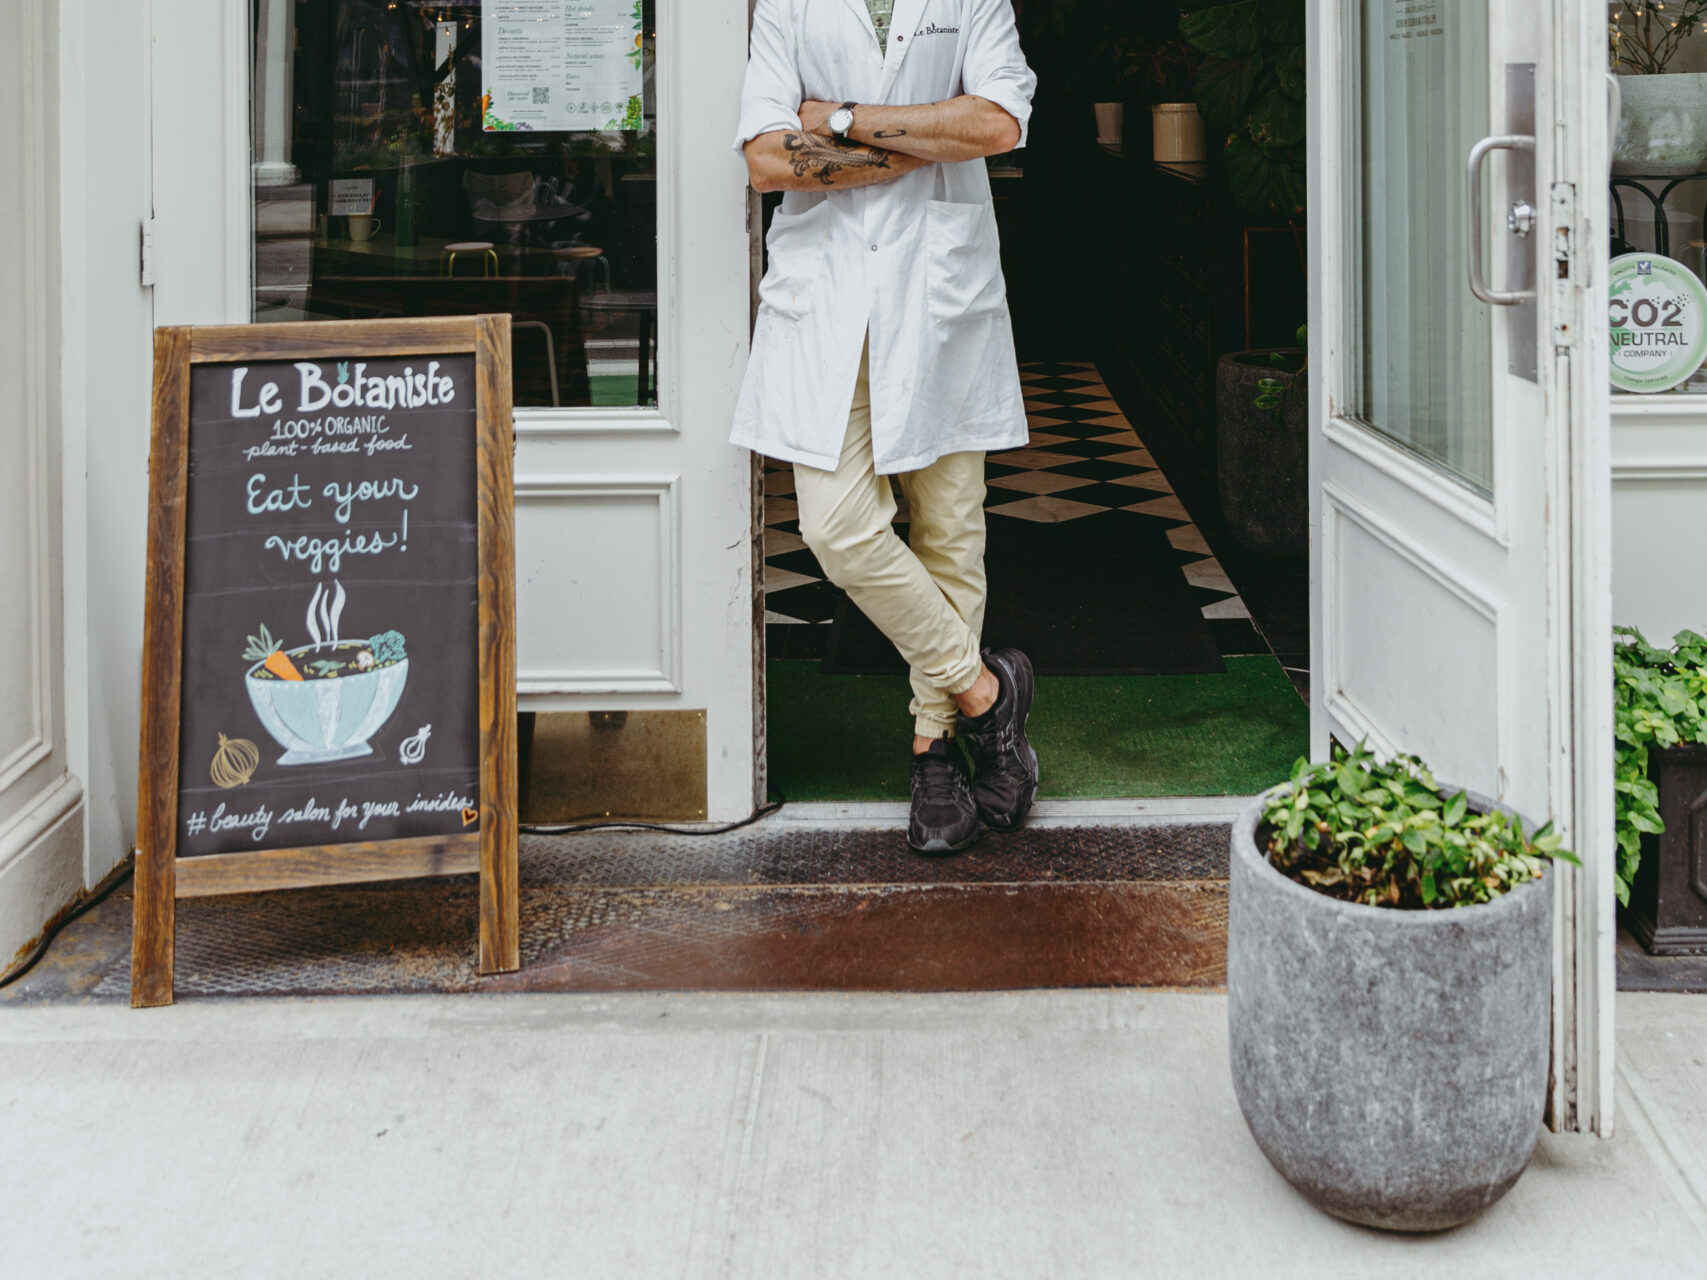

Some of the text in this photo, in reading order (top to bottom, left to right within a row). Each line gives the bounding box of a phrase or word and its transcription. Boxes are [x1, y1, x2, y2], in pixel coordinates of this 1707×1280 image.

[925, 23, 959, 35] Botaniste
[1609, 297, 1684, 328] CO2
[1609, 332, 1689, 346] NEUTRAL
[1623, 349, 1668, 358] COMPANY
[231, 361, 455, 418] Le Botaniste
[270, 415, 390, 440] 100% ORGANIC
[363, 433, 413, 457] food
[246, 473, 419, 524] Eat your
[264, 508, 408, 574] veggies!
[277, 797, 331, 824] salon
[330, 797, 358, 830] for
[358, 800, 401, 830] your
[405, 789, 474, 812] insides
